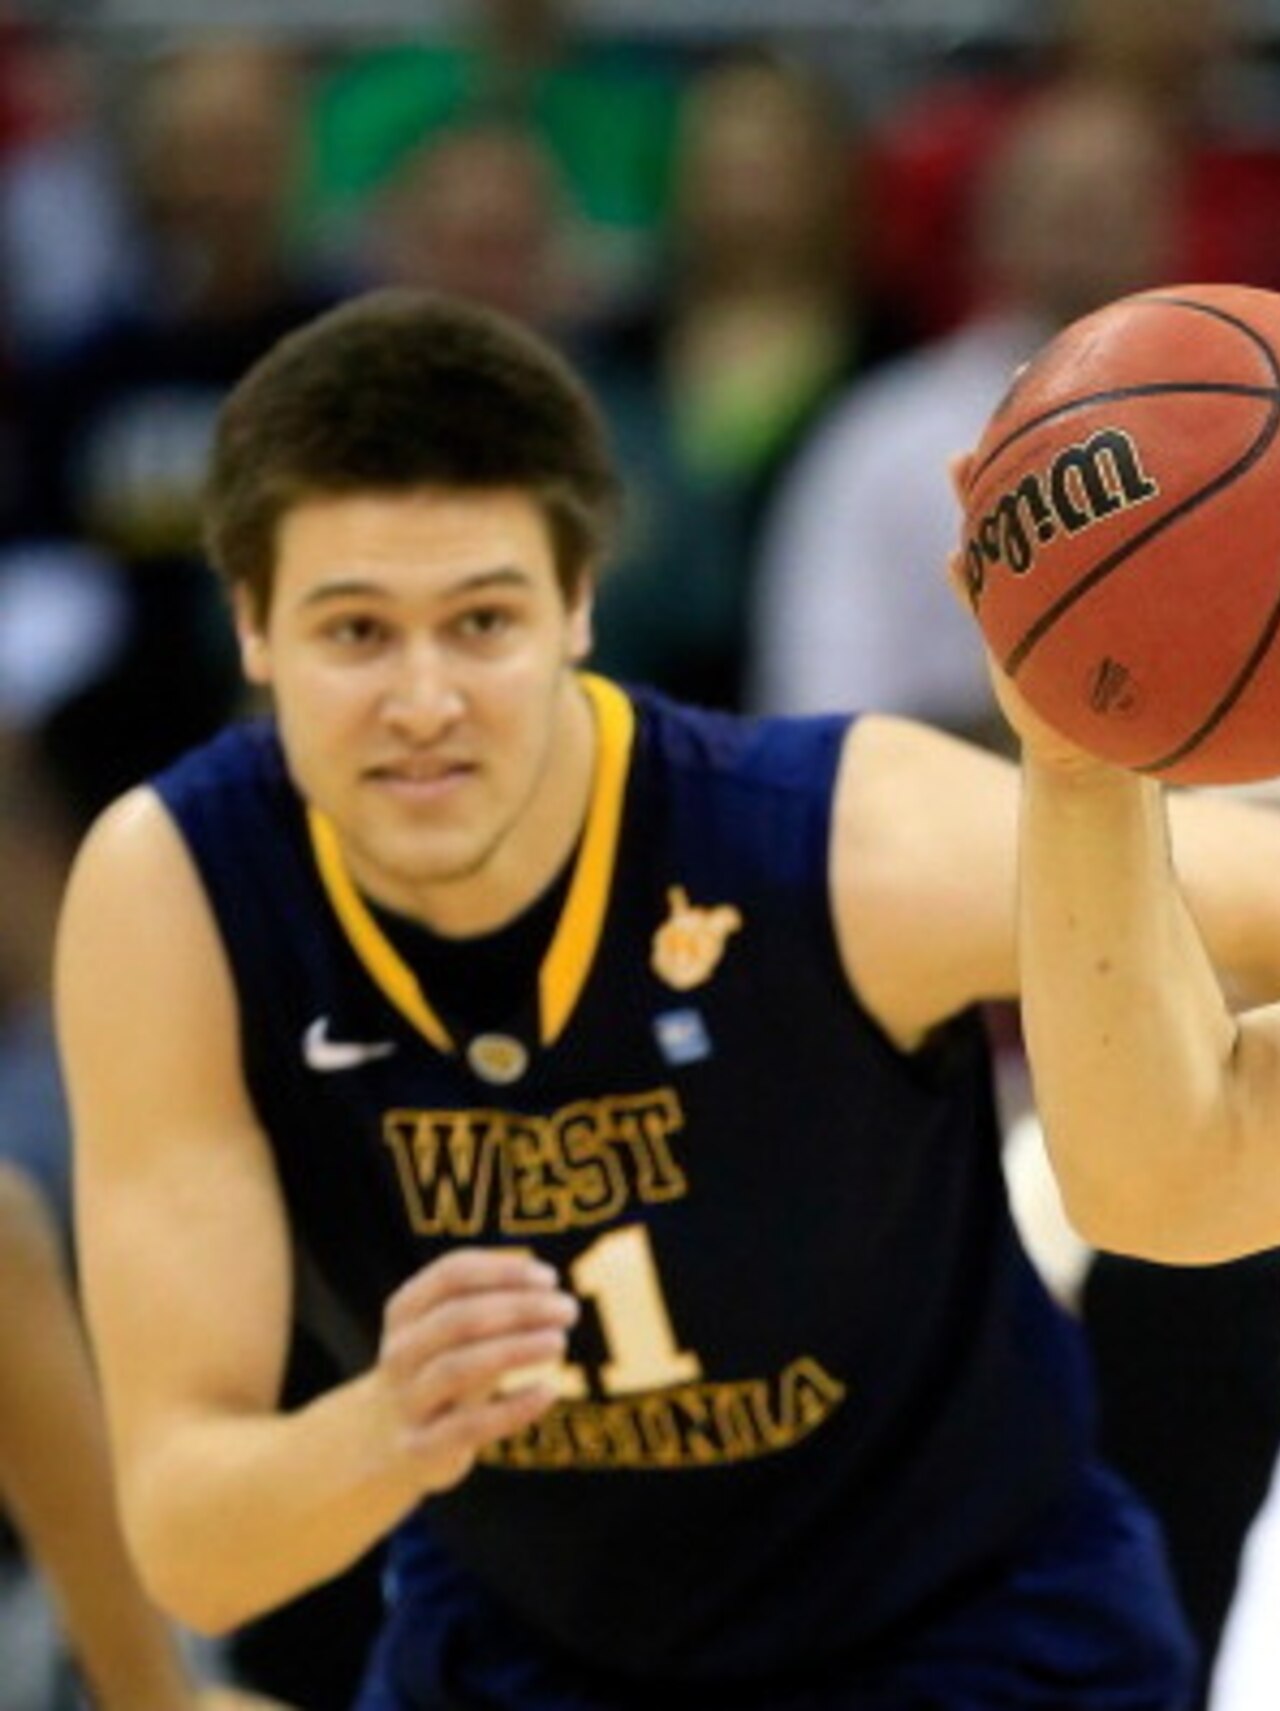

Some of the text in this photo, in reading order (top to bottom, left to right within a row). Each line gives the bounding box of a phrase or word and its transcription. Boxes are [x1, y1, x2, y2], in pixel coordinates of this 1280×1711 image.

[966, 428, 1160, 614] Wilso
[381, 1086, 689, 1236] WEST
[476, 1356, 847, 1469] GINIA
